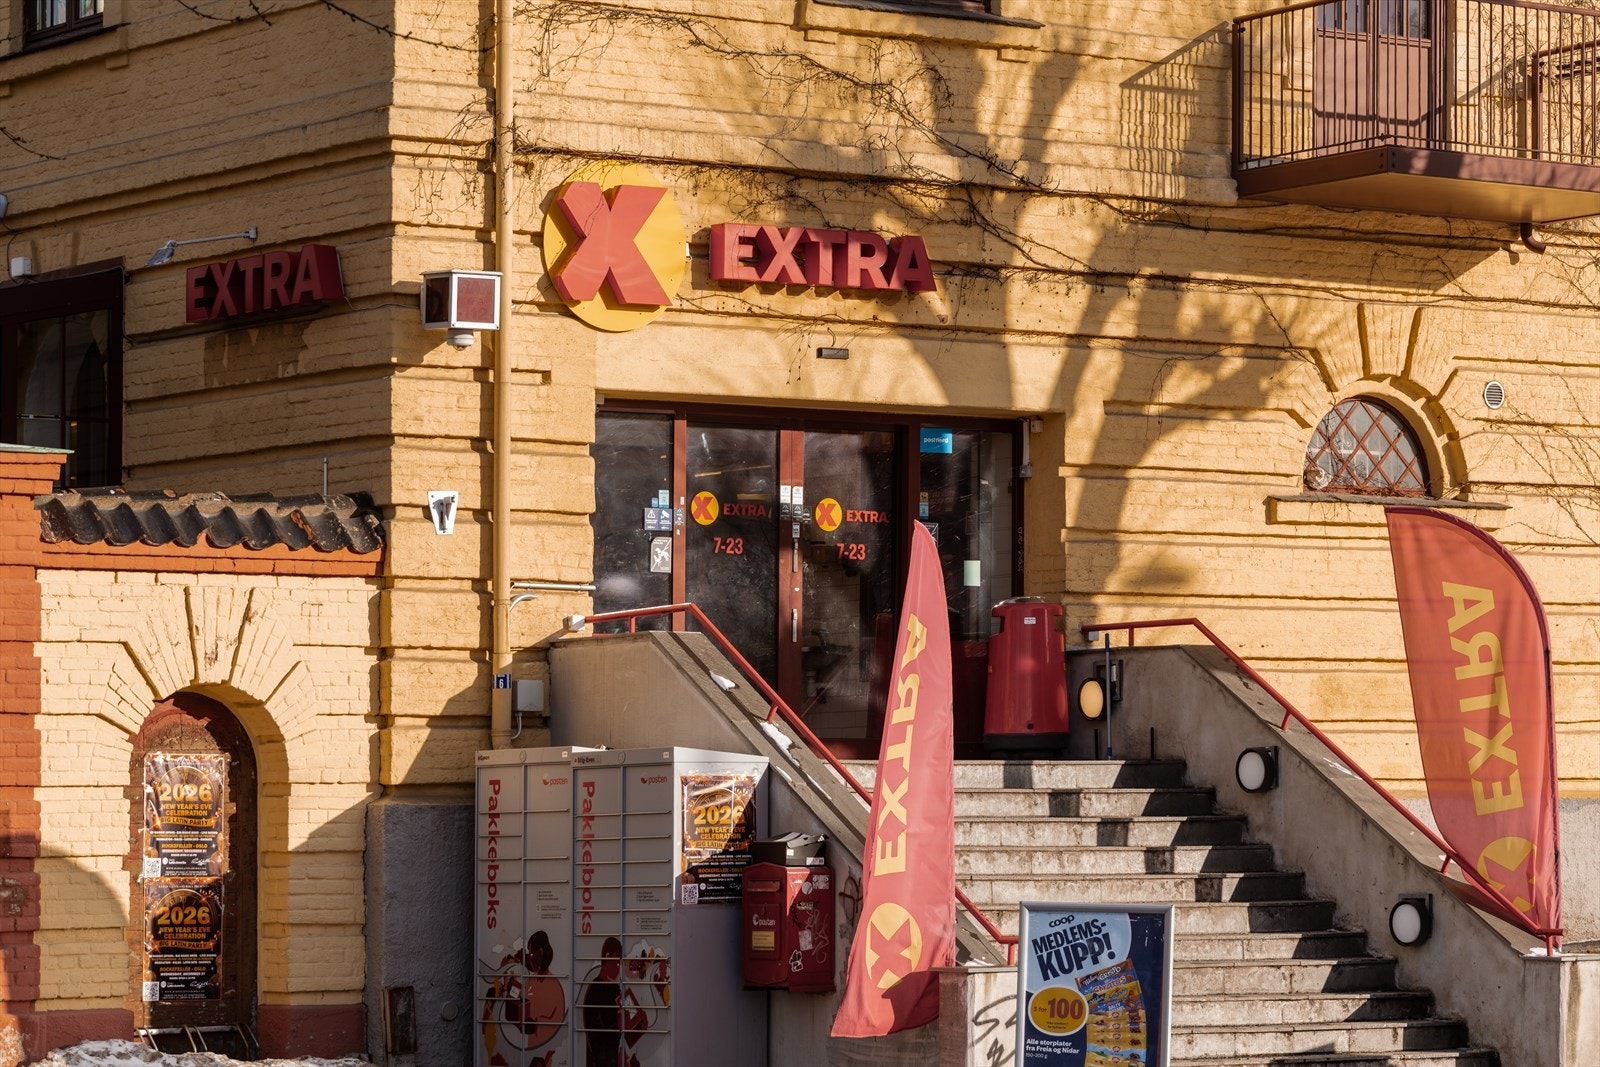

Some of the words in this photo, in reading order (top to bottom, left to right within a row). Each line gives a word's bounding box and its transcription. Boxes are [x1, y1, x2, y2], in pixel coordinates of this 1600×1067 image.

[555, 182, 672, 305] X
[711, 222, 937, 291] EXTRA
[186, 244, 330, 323] EXTRA
[723, 503, 767, 517] EXTRA
[846, 510, 889, 523] EXTRA
[713, 538, 744, 554] 7-23
[836, 543, 866, 560] 7-23
[499, 679, 504, 688] 6
[549, 776, 569, 786] posten
[648, 775, 668, 785] posten
[159, 783, 212, 801] 2026
[693, 806, 745, 824] 2026
[487, 779, 501, 929] Pakkeboks
[581, 782, 596, 934] Pakkeboks
[158, 906, 210, 924] 2026
[758, 919, 776, 927] posten
[1048, 915, 1075, 927] coop
[1031, 918, 1107, 955] MEDLEMS-
[1036, 932, 1116, 981] KUPP!
[1047, 998, 1084, 1020] 100
